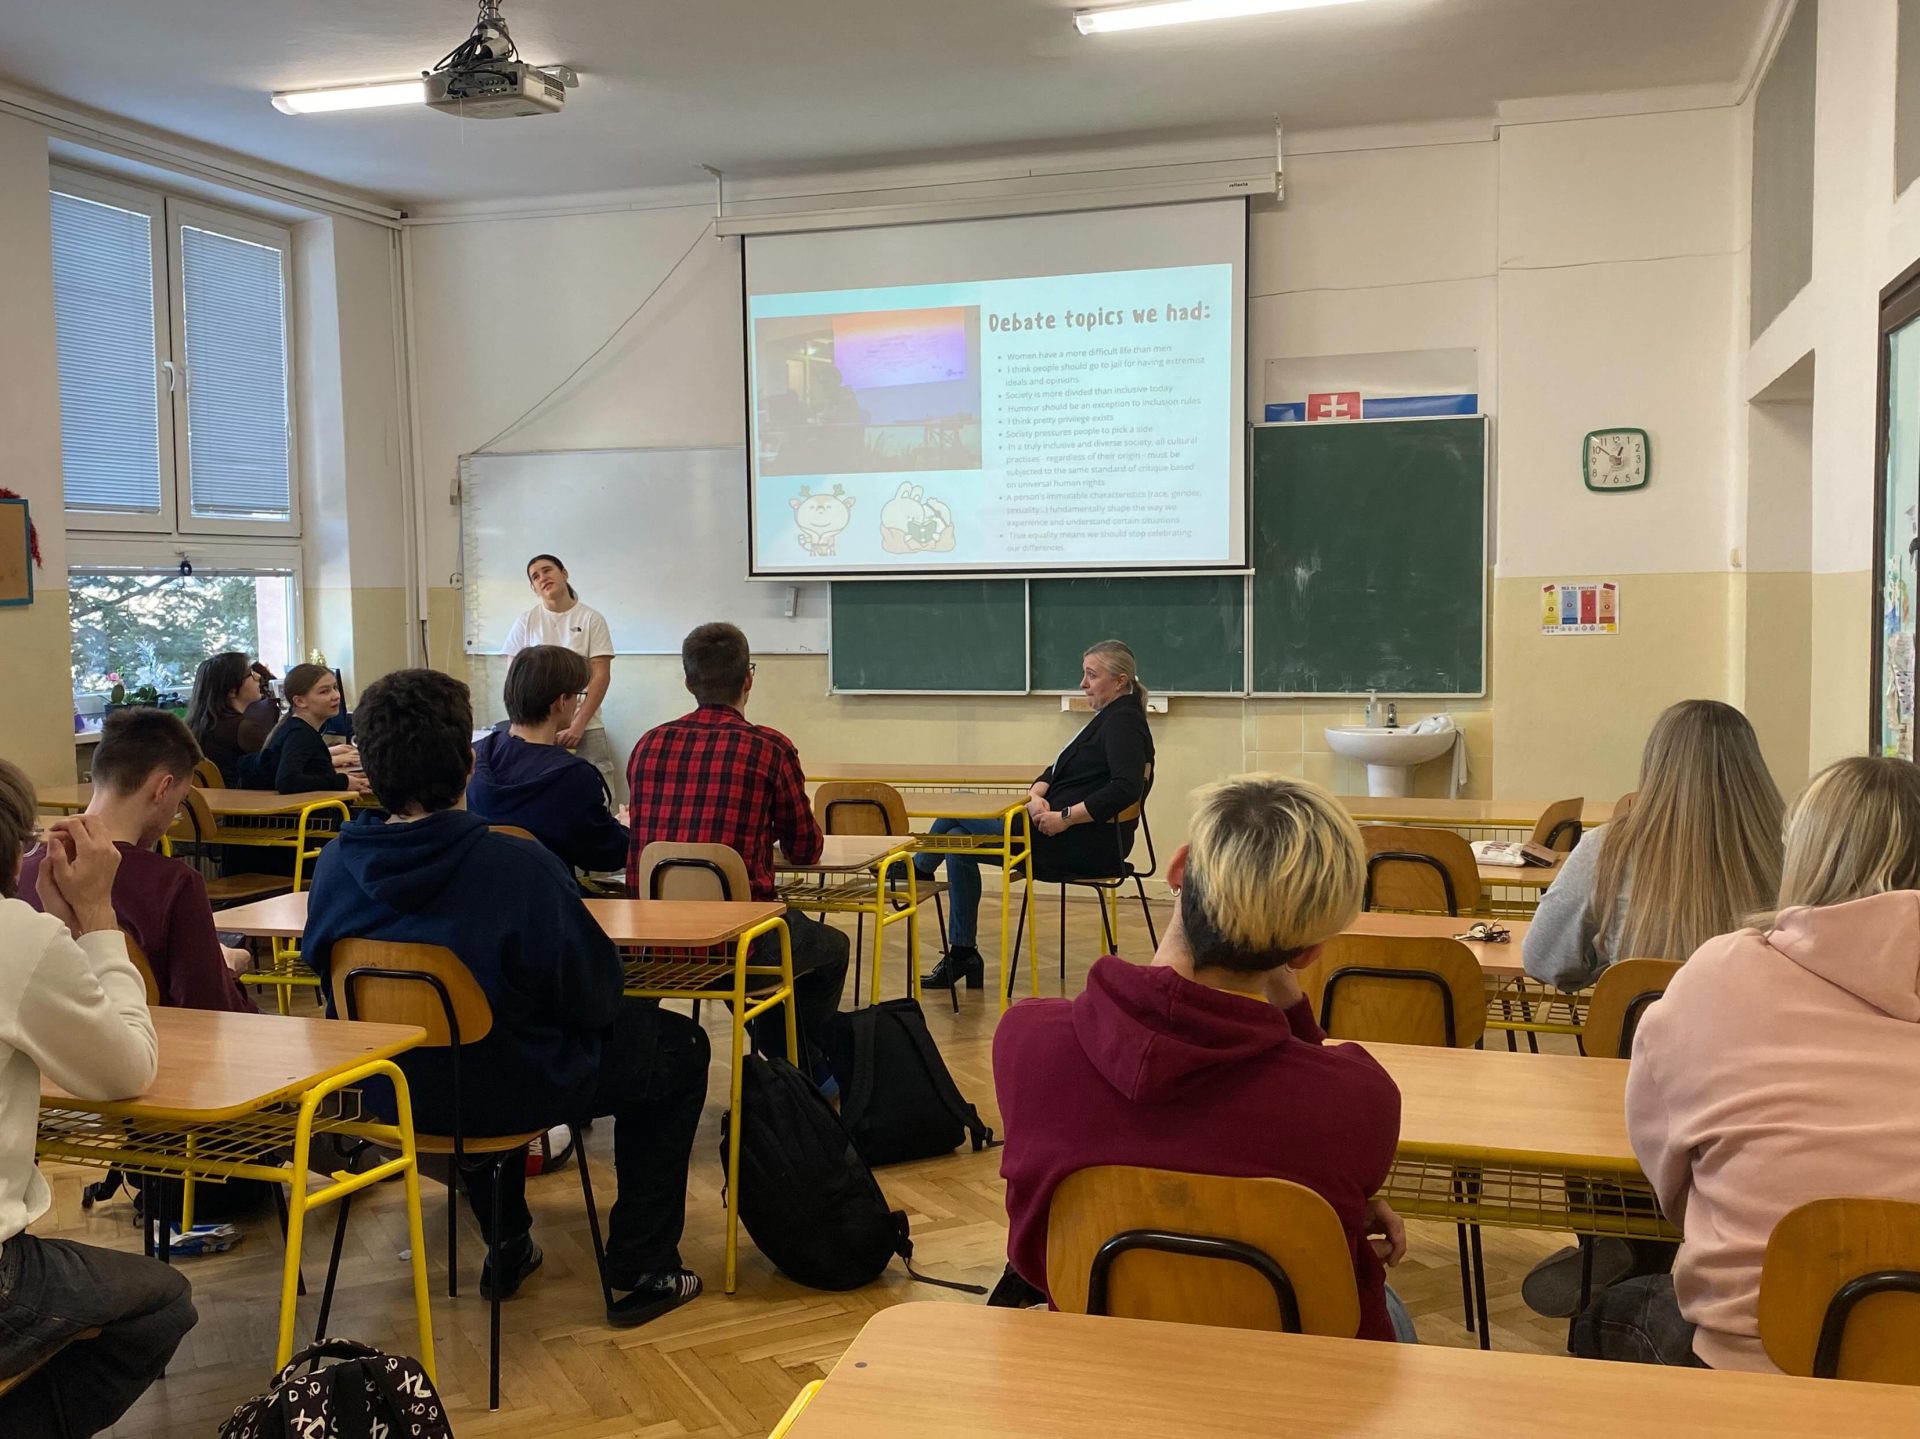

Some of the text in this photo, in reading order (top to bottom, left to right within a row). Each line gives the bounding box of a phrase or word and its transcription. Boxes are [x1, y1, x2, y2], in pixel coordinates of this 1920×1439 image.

[989, 301, 1210, 331] Debate topics we had:
[1007, 352, 1037, 360] Women
[1088, 348, 1118, 356] difficult
[1120, 347, 1132, 355] life
[1133, 346, 1151, 354] than
[1011, 365, 1031, 373] think
[1033, 364, 1059, 374] people
[1061, 363, 1088, 371] should
[1089, 363, 1099, 371] go
[1110, 361, 1122, 370] jail
[1124, 360, 1136, 368] for
[1137, 359, 1164, 369] having
[1005, 378, 1028, 386] ideals
[1046, 376, 1080, 386] opinions
[1005, 391, 1033, 401] Society
[1065, 389, 1093, 397] divided
[1115, 386, 1148, 395] inclusive
[1150, 385, 1173, 395] today
[1041, 403, 1068, 411] should
[1092, 401, 1131, 411] exception
[1132, 400, 1141, 408] to
[1142, 399, 1179, 407] inclusion
[1180, 398, 1201, 406] rules
[1033, 417, 1056, 426] pretty
[1058, 416, 1090, 425] privilege
[1005, 430, 1033, 440] Society
[1034, 430, 1072, 439] pressures
[1073, 428, 1100, 437] people
[1111, 427, 1128, 436] pick
[1136, 426, 1153, 434] side
[1024, 442, 1041, 452] truly
[1043, 441, 1075, 449] inclusive
[1093, 440, 1122, 448] diverse
[1155, 438, 1165, 446] all
[1167, 437, 1198, 445] cultural
[1600, 438, 1607, 446] 11
[1627, 436, 1630, 445] 1
[1592, 446, 1601, 455] 10
[1635, 443, 1641, 452] 2
[1046, 454, 1085, 464] regardless
[1097, 453, 1115, 461] their
[1117, 452, 1141, 462] origin
[1170, 451, 1181, 459] be
[1591, 457, 1597, 465] 9
[1636, 455, 1641, 463] 3
[1006, 468, 1043, 477] subjected
[1044, 467, 1052, 475] to
[1054, 467, 1066, 475] the
[1091, 465, 1126, 473] standard
[1138, 464, 1168, 474] critique
[1592, 469, 1598, 478] 8
[1634, 467, 1640, 475] 4
[1602, 475, 1608, 483] 7
[1613, 475, 1619, 483] 6
[1625, 474, 1631, 482] 5
[1018, 480, 1052, 488] universal
[1082, 479, 1105, 488] rights
[1050, 505, 1105, 515] fundamentally
[1107, 505, 1131, 514] shape
[1132, 504, 1145, 512] the
[1147, 505, 1162, 513] way
[1066, 518, 1111, 526] understand
[1028, 531, 1058, 541] equality
[1100, 530, 1127, 538] should
[1128, 530, 1146, 539] stop
